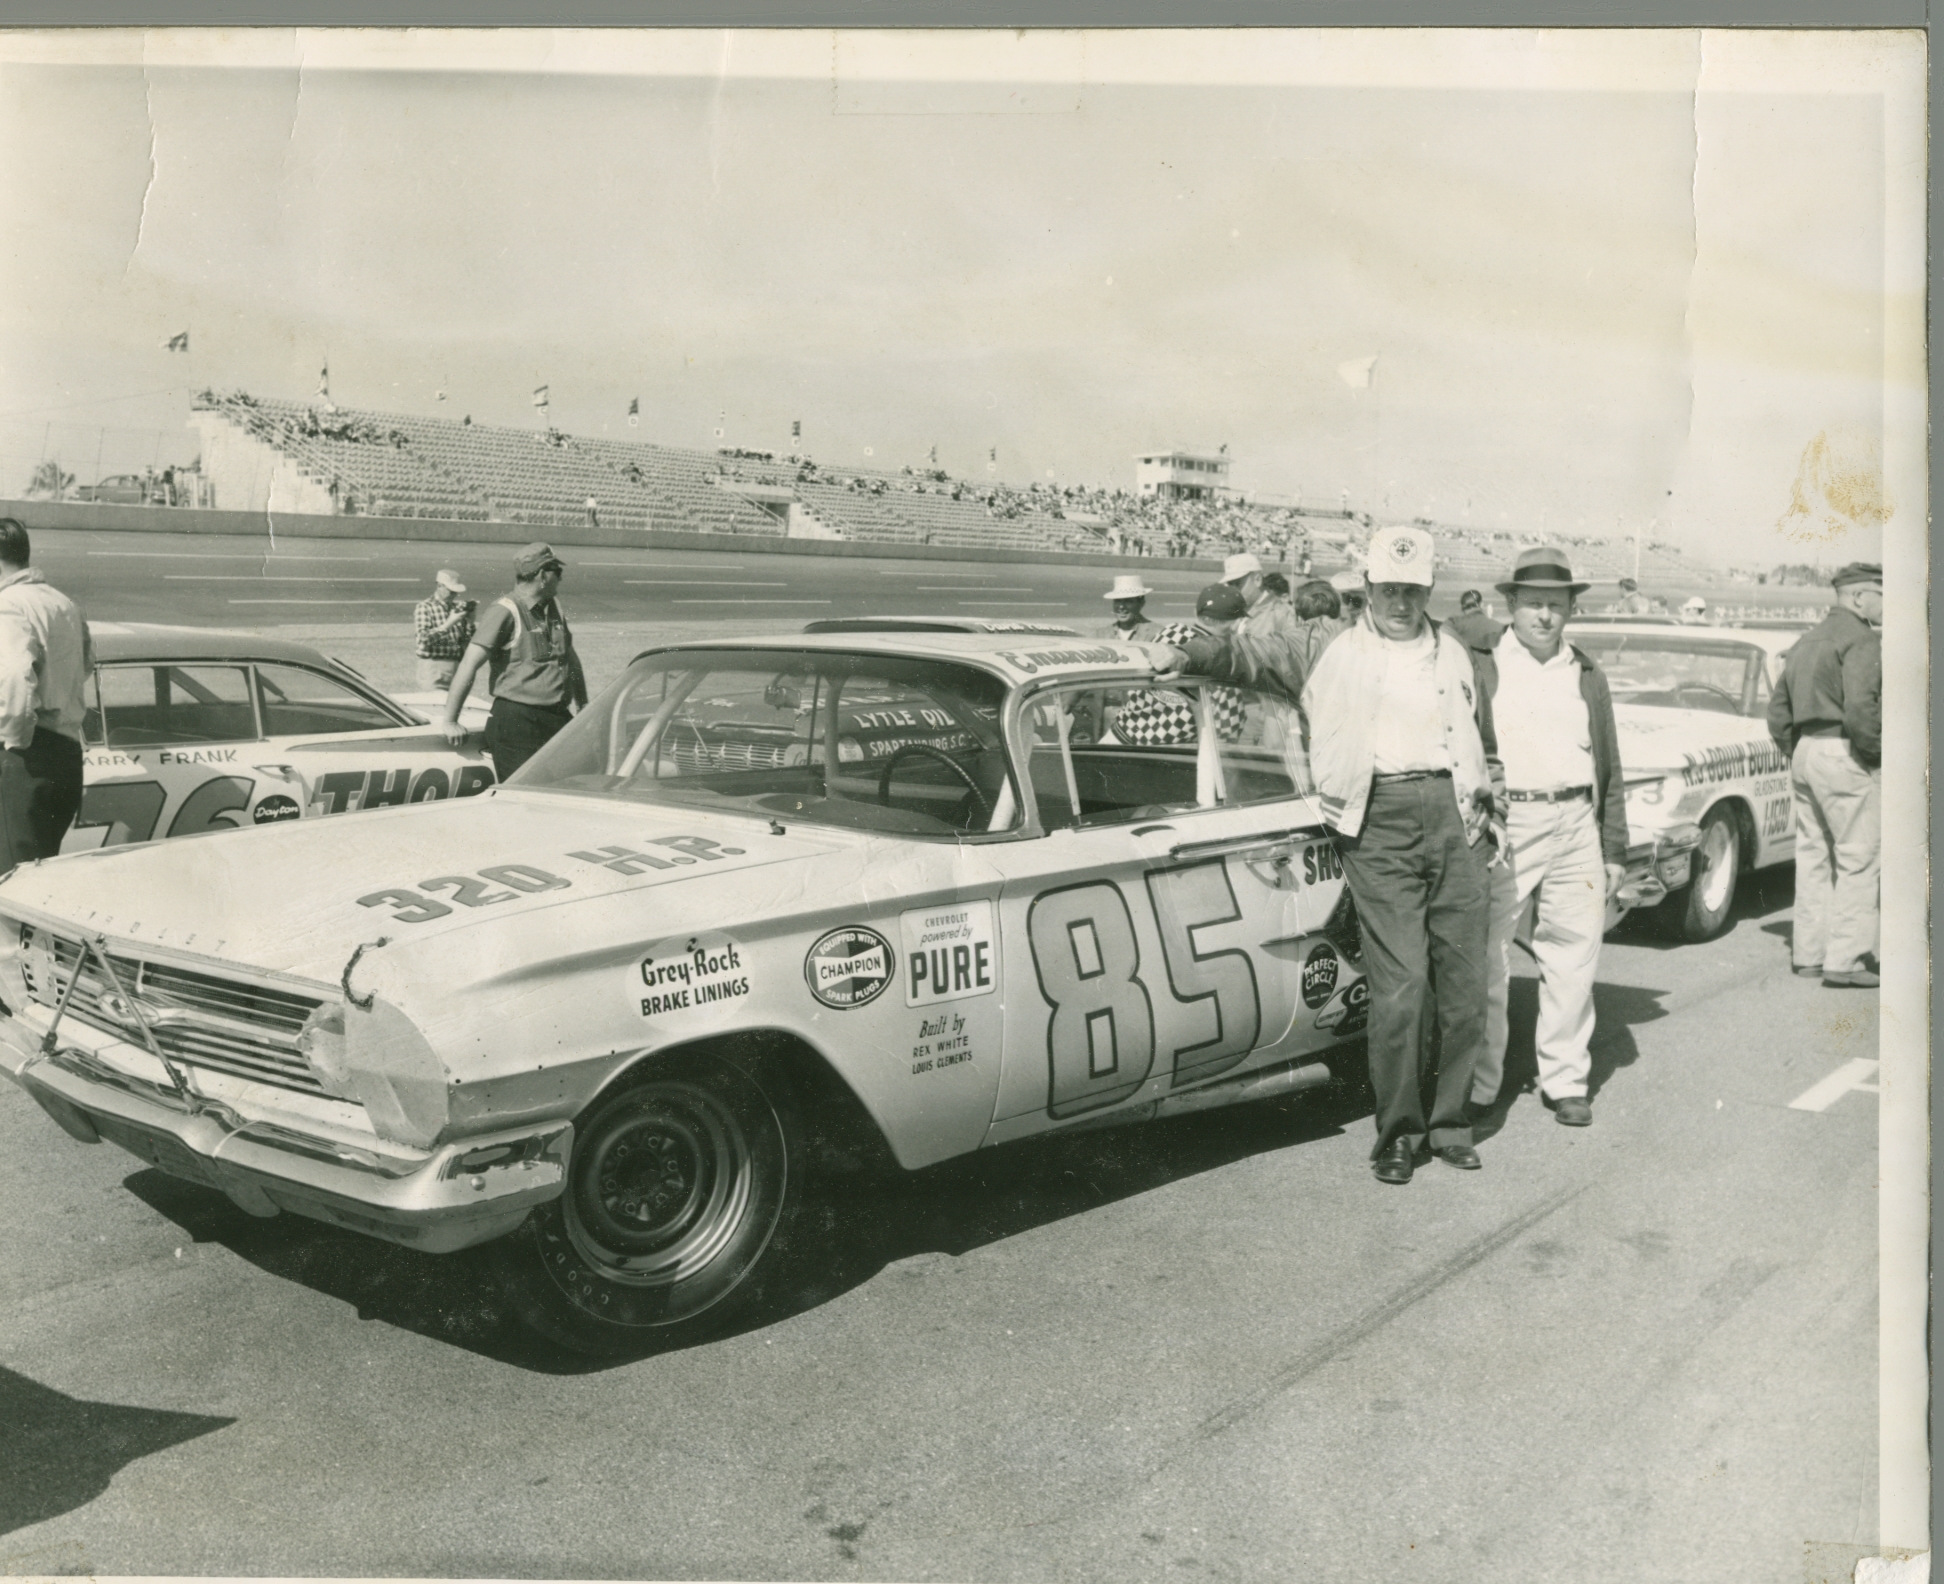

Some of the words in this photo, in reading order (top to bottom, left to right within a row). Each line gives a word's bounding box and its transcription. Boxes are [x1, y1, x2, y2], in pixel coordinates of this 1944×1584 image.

[852, 709, 916, 729] LYTLE
[920, 708, 956, 727] OIL
[82, 754, 141, 766] ARRY
[159, 749, 238, 765] FRANK
[255, 804, 299, 819] Dayton
[356, 864, 572, 923] 320
[565, 835, 747, 876] H.P.
[925, 912, 969, 928] CHEVROLET
[819, 932, 856, 956] EQUIPPED
[857, 932, 877, 946] WITH
[919, 925, 961, 947] powered
[962, 924, 973, 940] by
[820, 955, 881, 980] CHAMPION
[909, 941, 991, 999] PURE
[1304, 958, 1339, 979] PERFECT
[826, 989, 853, 1003] SPARK
[855, 979, 880, 1000] PLUGS
[1026, 854, 1261, 1121] 85
[1305, 971, 1334, 991] CIRCLE
[641, 990, 690, 1016] BRAKE
[694, 976, 749, 1005] LININGS
[919, 1016, 947, 1038] Built
[952, 1013, 966, 1035] by
[913, 1044, 931, 1058] REX
[937, 1036, 969, 1052] WHITE
[912, 1060, 933, 1075] LOUIS
[936, 1051, 973, 1069] CLEMENTS
